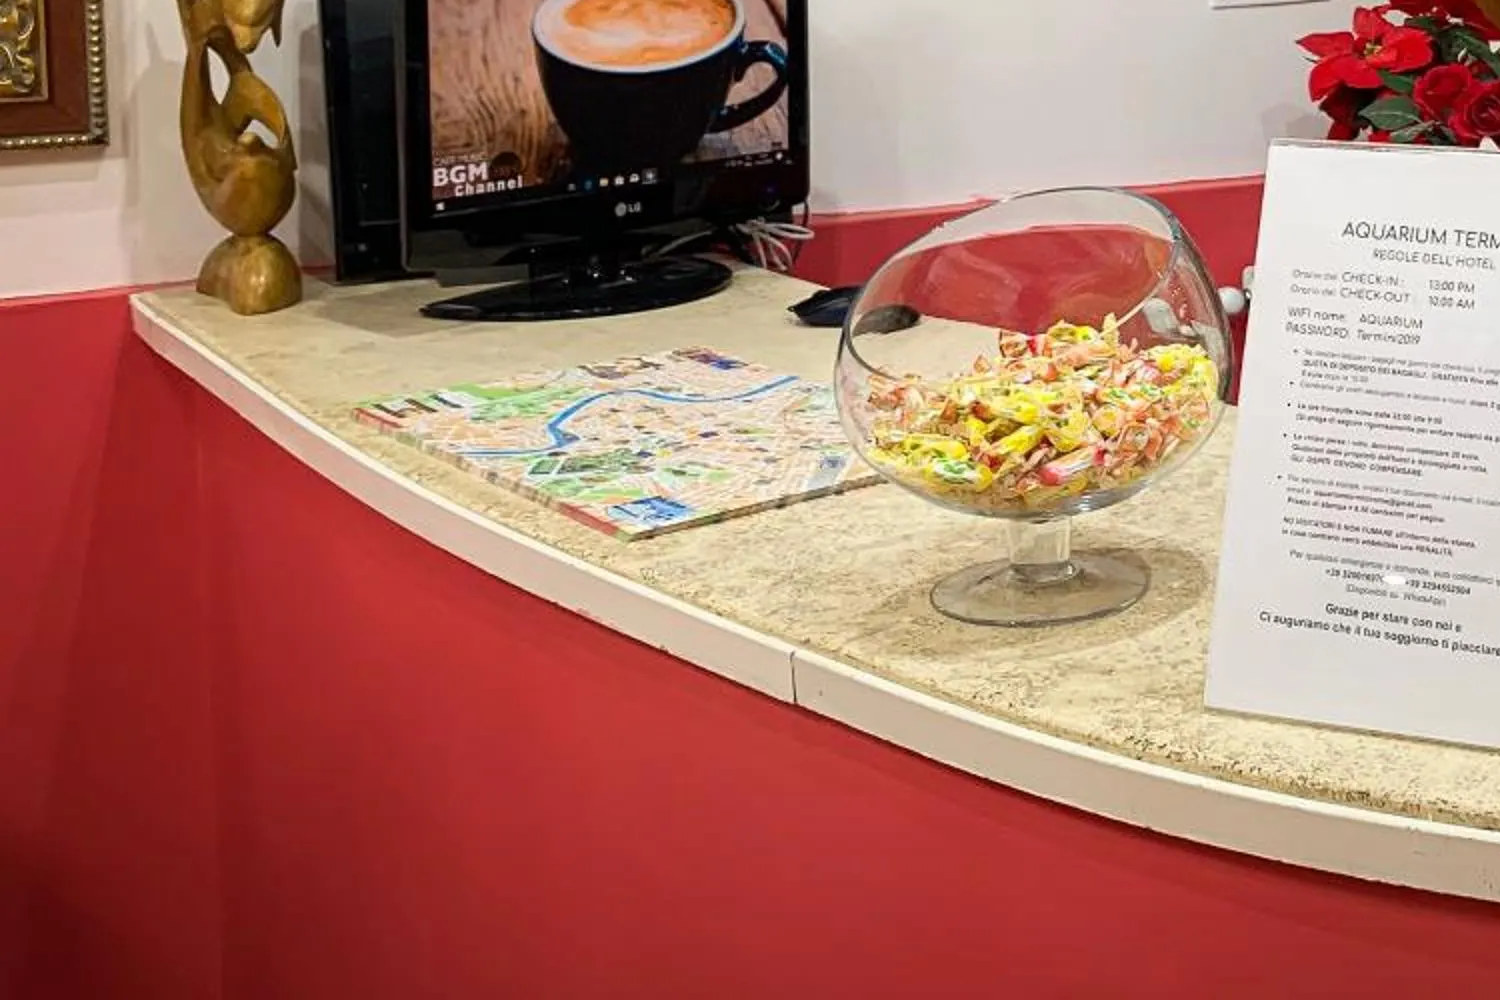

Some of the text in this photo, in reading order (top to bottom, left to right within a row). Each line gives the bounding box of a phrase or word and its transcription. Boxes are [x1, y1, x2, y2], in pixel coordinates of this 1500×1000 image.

[432, 161, 489, 187] BGM
[454, 175, 524, 197] Channel
[628, 202, 642, 213] LG
[1342, 221, 1447, 244] AQUARIUM
[1372, 247, 1420, 263] REGOLE
[1456, 280, 1475, 293] PM
[1455, 298, 1475, 309] AM
[1288, 306, 1311, 317] WIFI
[1358, 312, 1423, 329] AQUARIUM
[1356, 328, 1421, 345] Termini2019
[1324, 602, 1359, 617] Grazie
[1361, 610, 1379, 621] per
[1381, 612, 1409, 625] stare
[1411, 617, 1433, 628] con
[1434, 620, 1452, 631] noi
[1272, 615, 1330, 631] auguriamo
[1331, 622, 1351, 634] che
[1362, 626, 1381, 639] tuo
[1383, 631, 1439, 647] soggiorno
